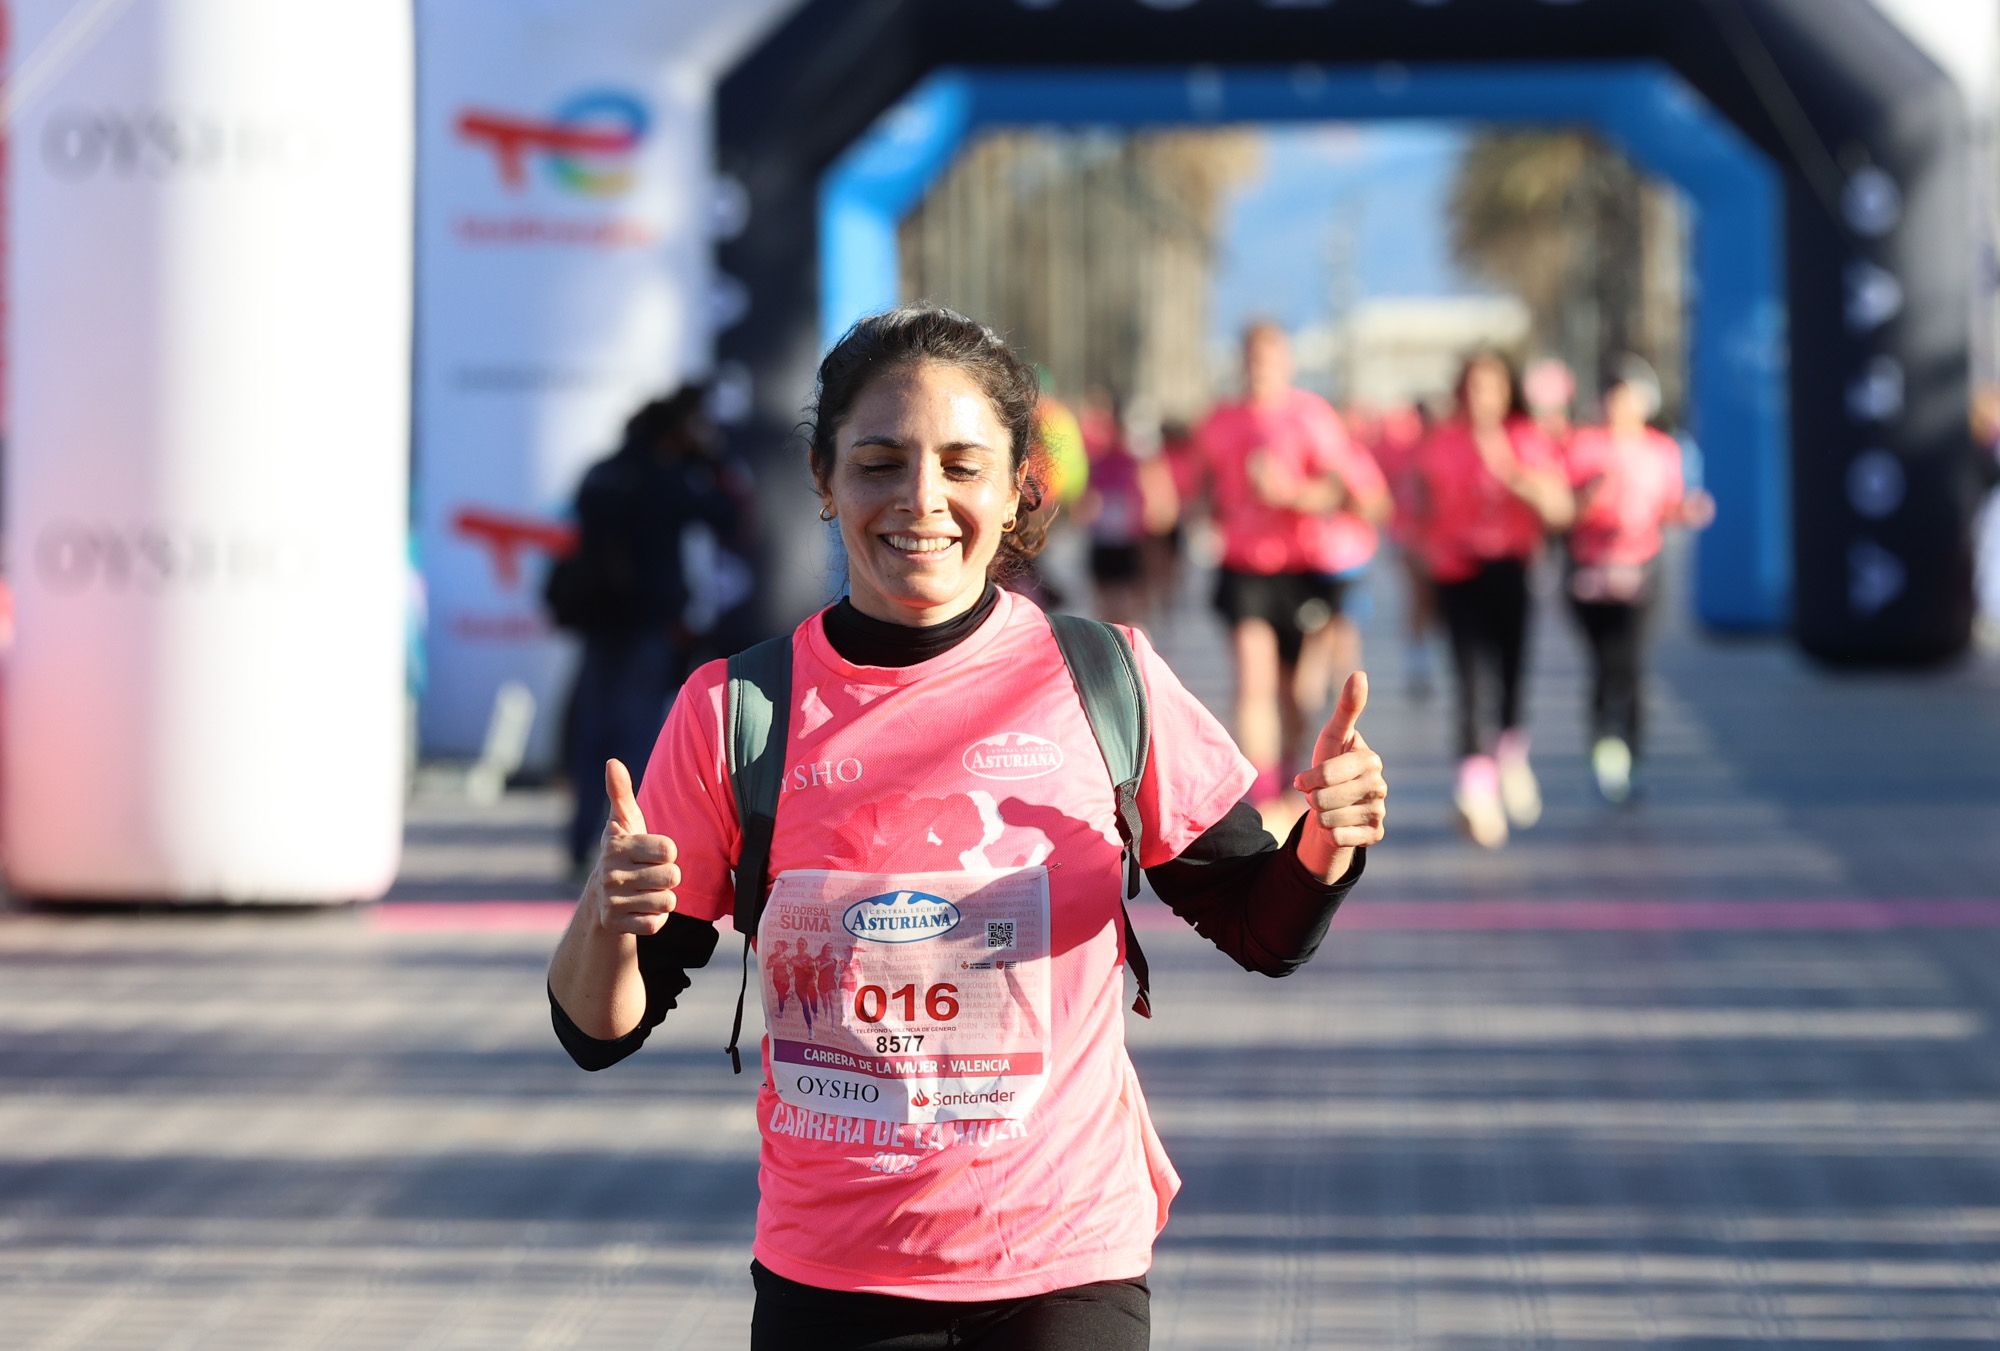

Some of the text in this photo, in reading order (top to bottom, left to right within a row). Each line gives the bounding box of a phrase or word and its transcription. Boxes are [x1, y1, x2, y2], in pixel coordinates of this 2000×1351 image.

[971, 750, 1057, 769] ASTURIANA
[781, 757, 863, 793] YSHO
[780, 904, 791, 914] TU
[793, 906, 831, 917] DORSAL
[851, 909, 952, 931] ASTURIANA
[869, 907, 907, 915] CENTRAL
[780, 915, 832, 933] SUMA
[853, 982, 960, 1024] 016
[876, 1035, 925, 1053] 8577
[803, 1048, 1011, 1074] CARRERA DE LA MUJER VALENCIA
[796, 1075, 880, 1103] OYSHO
[932, 1089, 1016, 1107] Santander
[769, 1102, 865, 1145] CARRERA
[873, 1119, 905, 1148] DE
[914, 1122, 945, 1150] LA
